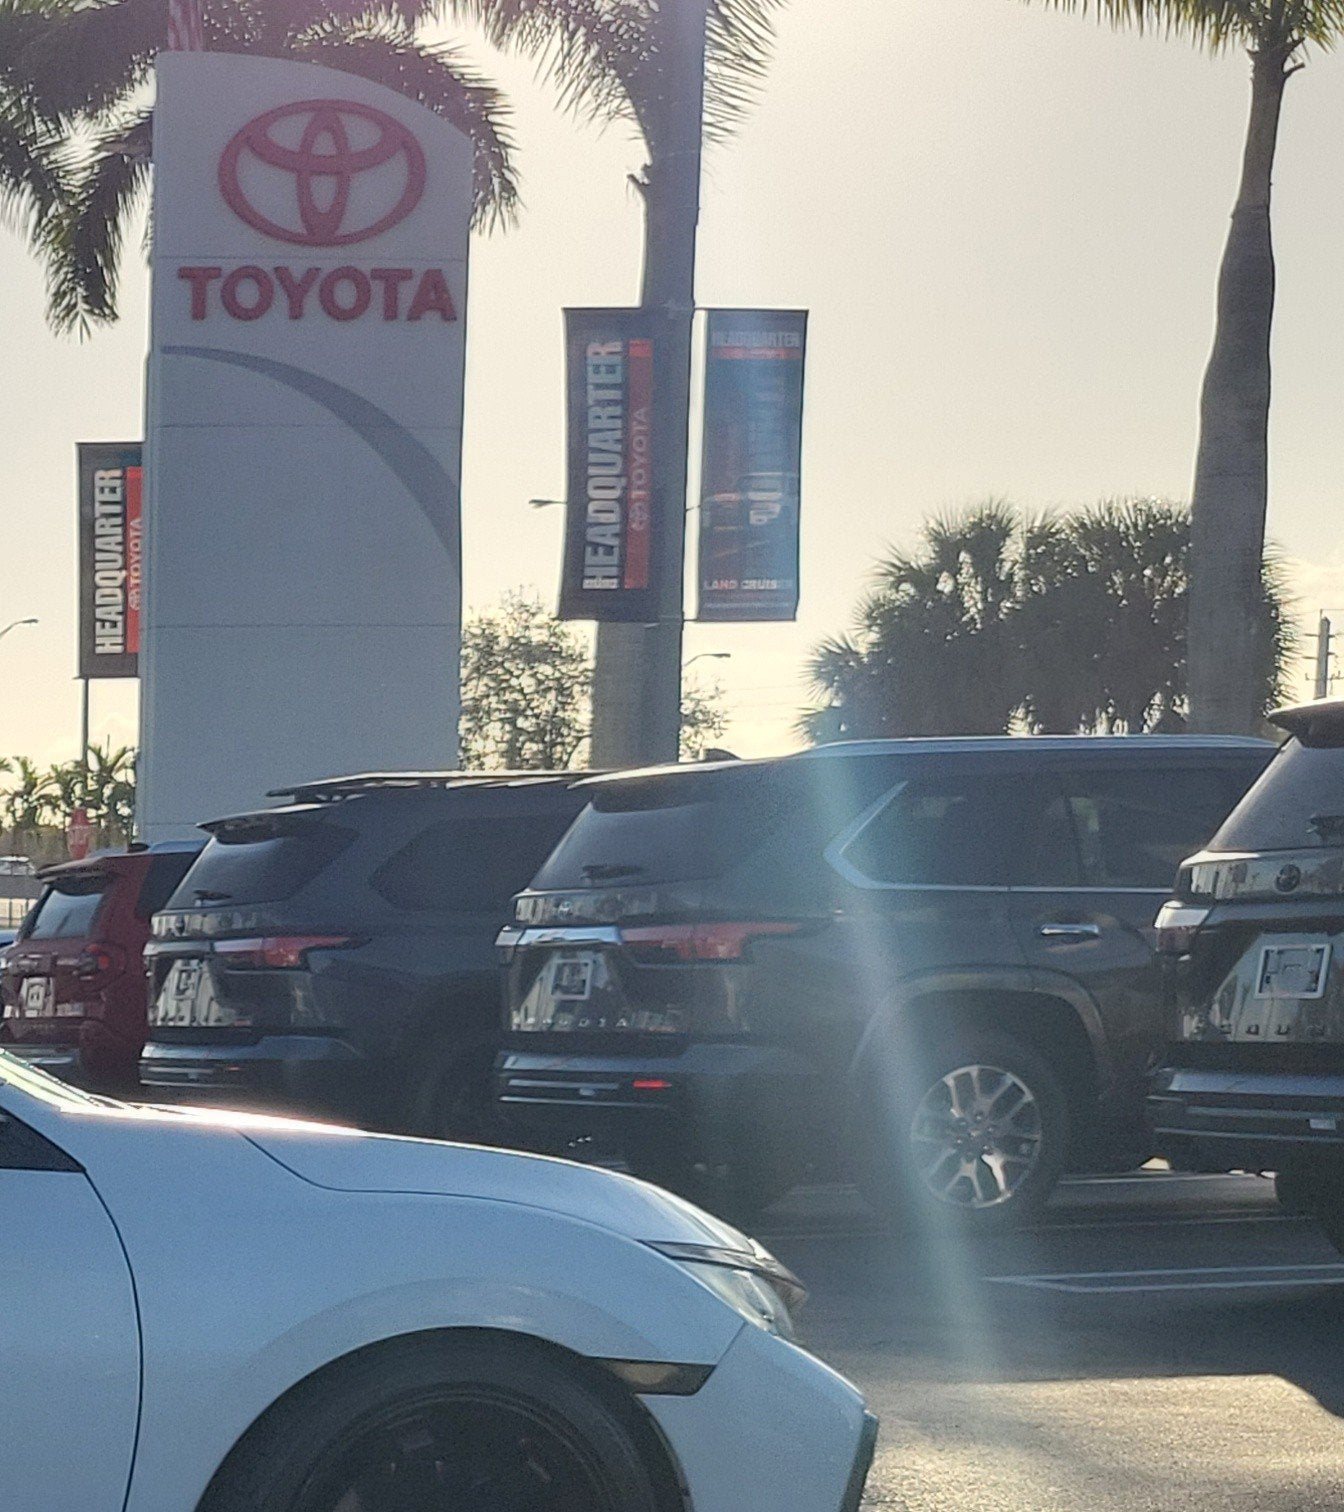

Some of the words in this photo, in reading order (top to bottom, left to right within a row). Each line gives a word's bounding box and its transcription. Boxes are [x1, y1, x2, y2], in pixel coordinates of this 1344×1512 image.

[178, 265, 458, 321] TOYOTA
[582, 341, 627, 589] HEADQUARTER
[631, 408, 650, 503] TOYOTA
[95, 469, 127, 654] HEADQUARTER
